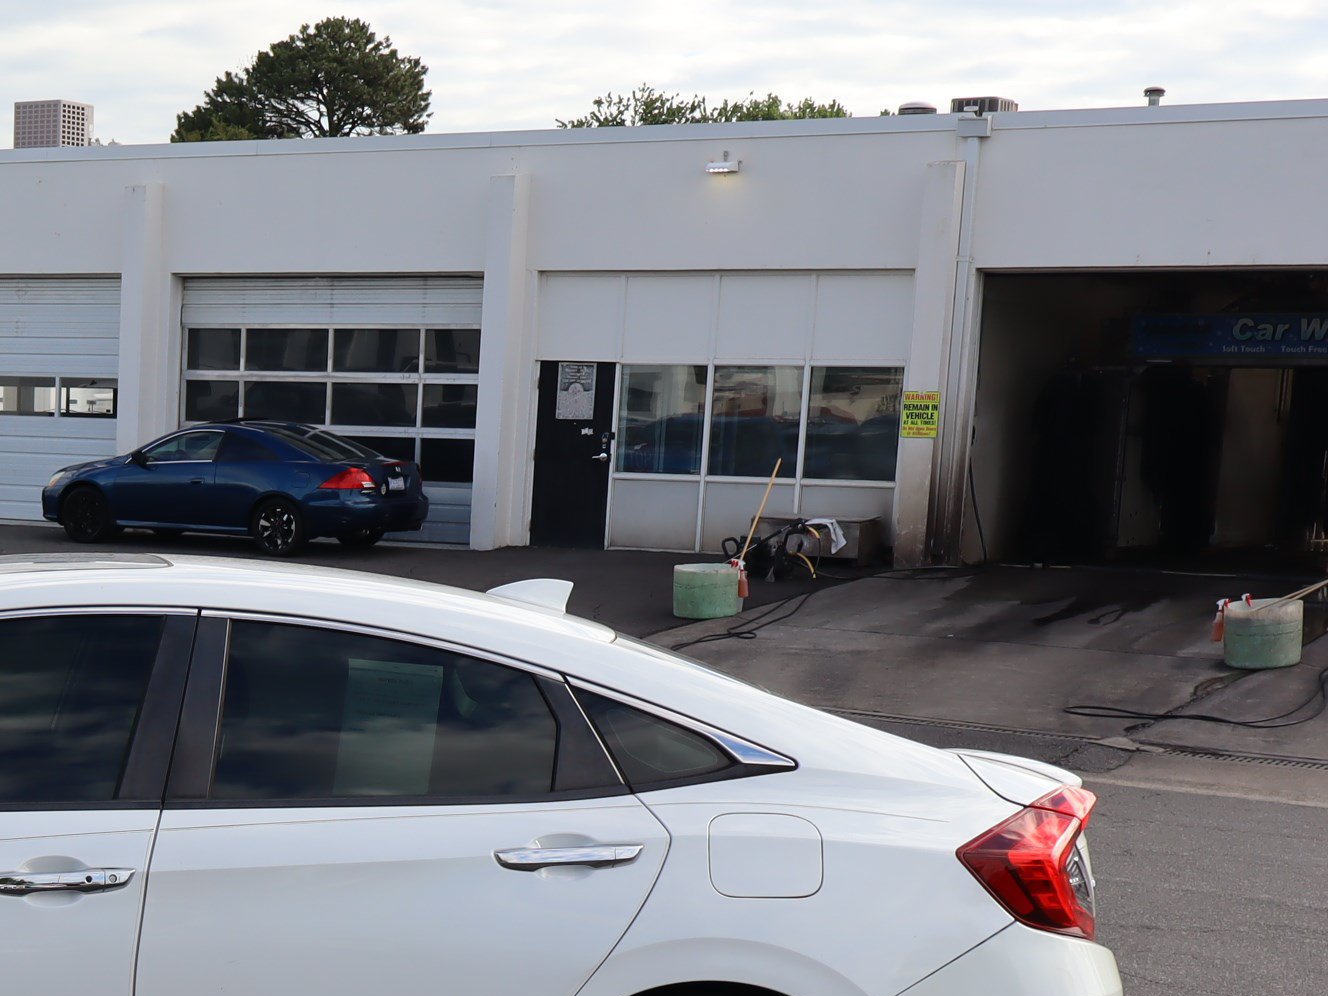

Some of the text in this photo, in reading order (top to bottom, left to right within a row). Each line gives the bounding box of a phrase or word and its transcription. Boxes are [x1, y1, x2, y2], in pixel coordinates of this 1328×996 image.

[1232, 317, 1291, 341] Car
[1240, 345, 1265, 353] Touch
[1280, 345, 1306, 353] Touch
[904, 393, 939, 401] WARNING!
[903, 403, 939, 411] REMAIN IN
[905, 412, 935, 420] VEHICLE
